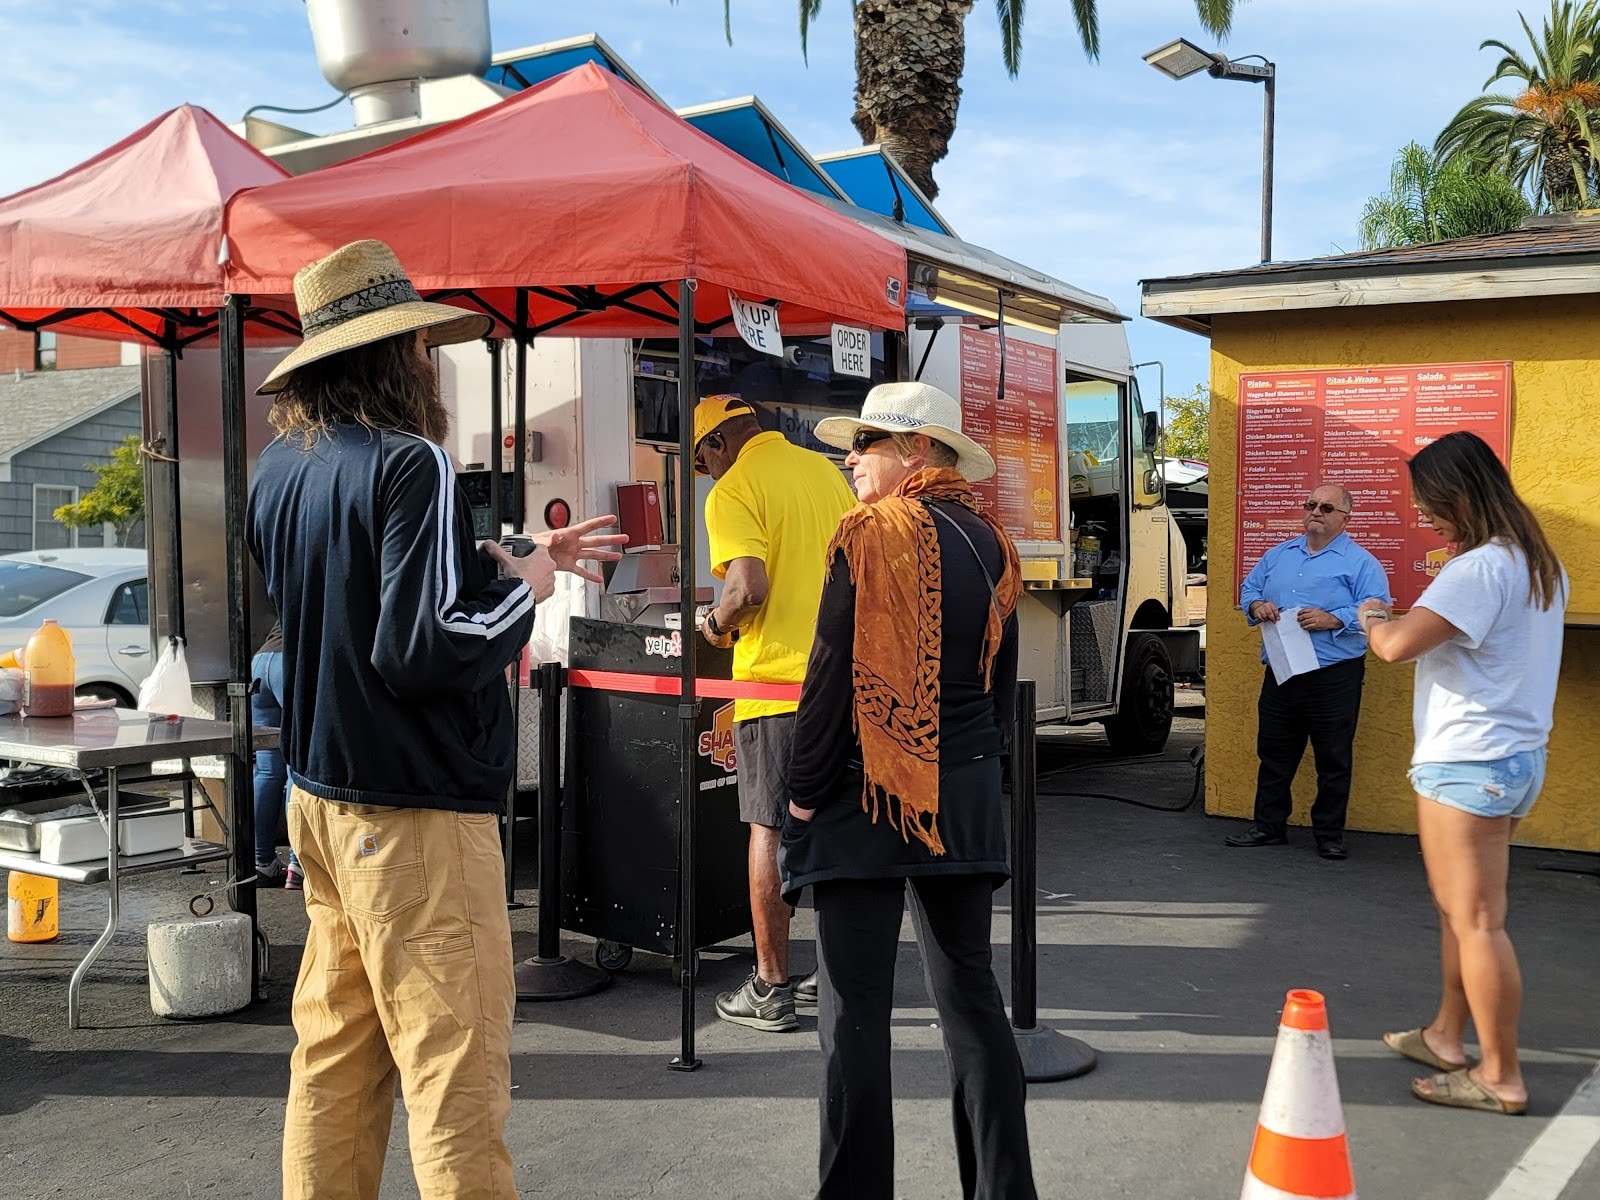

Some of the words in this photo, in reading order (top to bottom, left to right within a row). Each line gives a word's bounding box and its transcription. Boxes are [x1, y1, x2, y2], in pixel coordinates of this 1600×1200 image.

[749, 305, 771, 327] UP
[837, 329, 866, 352] ORDER
[842, 352, 864, 372] HERE
[1355, 376, 1378, 384] Wraps
[1417, 372, 1444, 380] Salads
[647, 638, 671, 655] yelp
[700, 780, 716, 790] HOME
